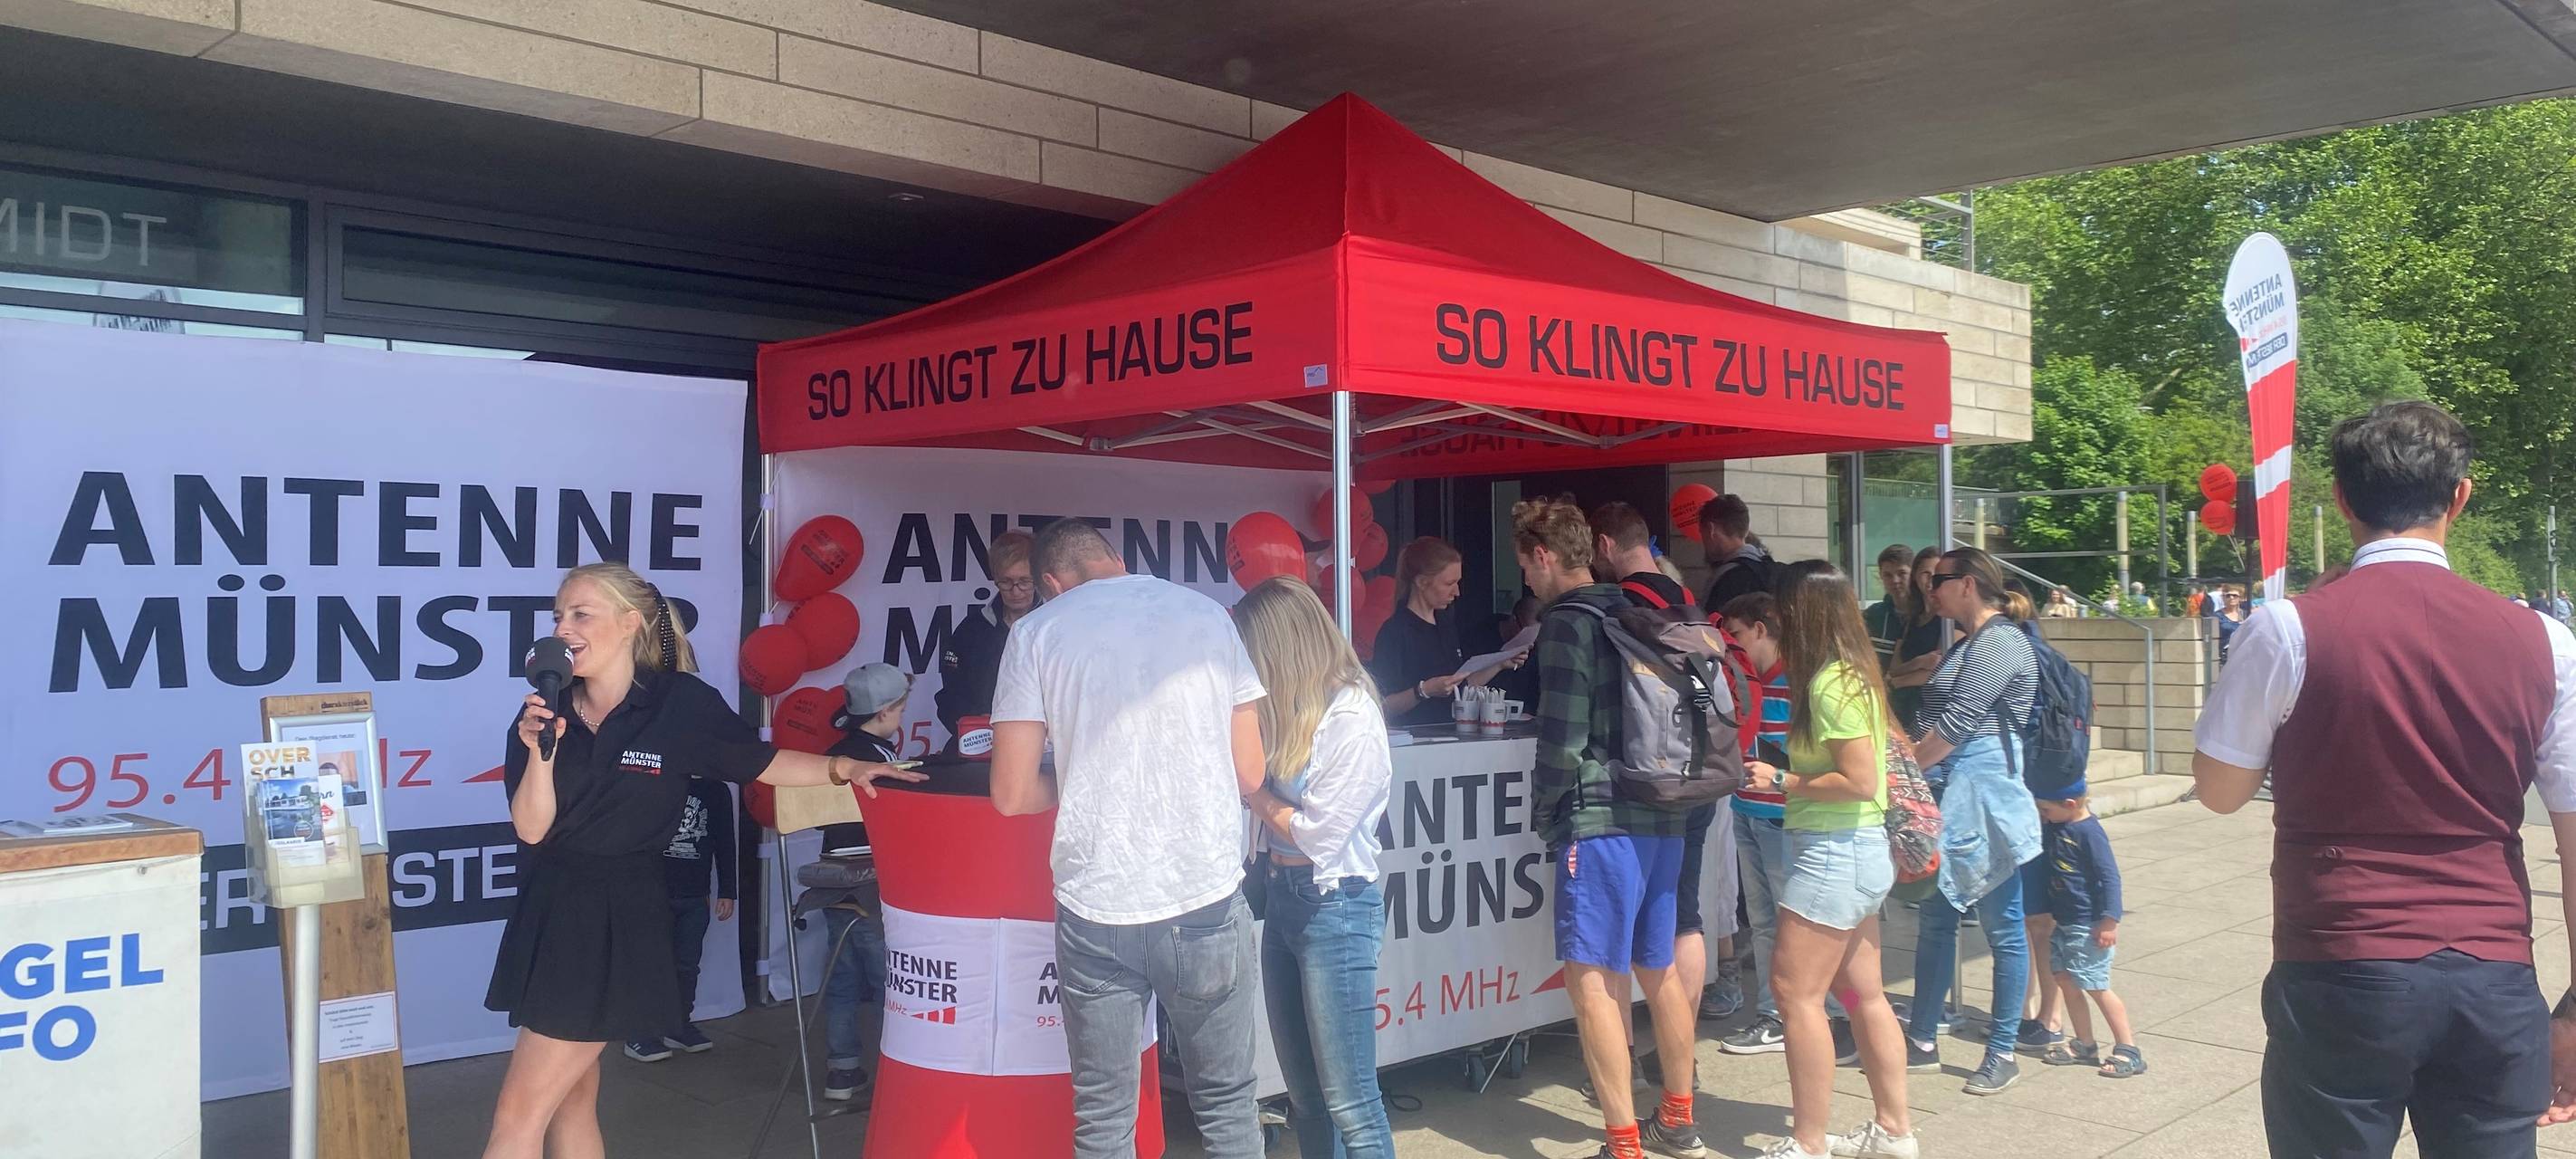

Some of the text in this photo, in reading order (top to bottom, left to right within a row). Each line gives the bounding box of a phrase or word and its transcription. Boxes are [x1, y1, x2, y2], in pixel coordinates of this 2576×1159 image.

[807, 302, 1254, 421] SO KLINGT ZU HAUSE
[1436, 304, 1905, 412] SO KLINGT ZU HAUSE
[48, 471, 703, 570] ANTENNE
[48, 574, 701, 693] MÜNST
[248, 747, 311, 766] OVER
[620, 756, 662, 769] MÜNSTER
[622, 750, 663, 762] ANTENNE
[962, 732, 991, 743] ANTENNE
[48, 748, 232, 813] 95.4
[1440, 964, 1521, 1016] MHz
